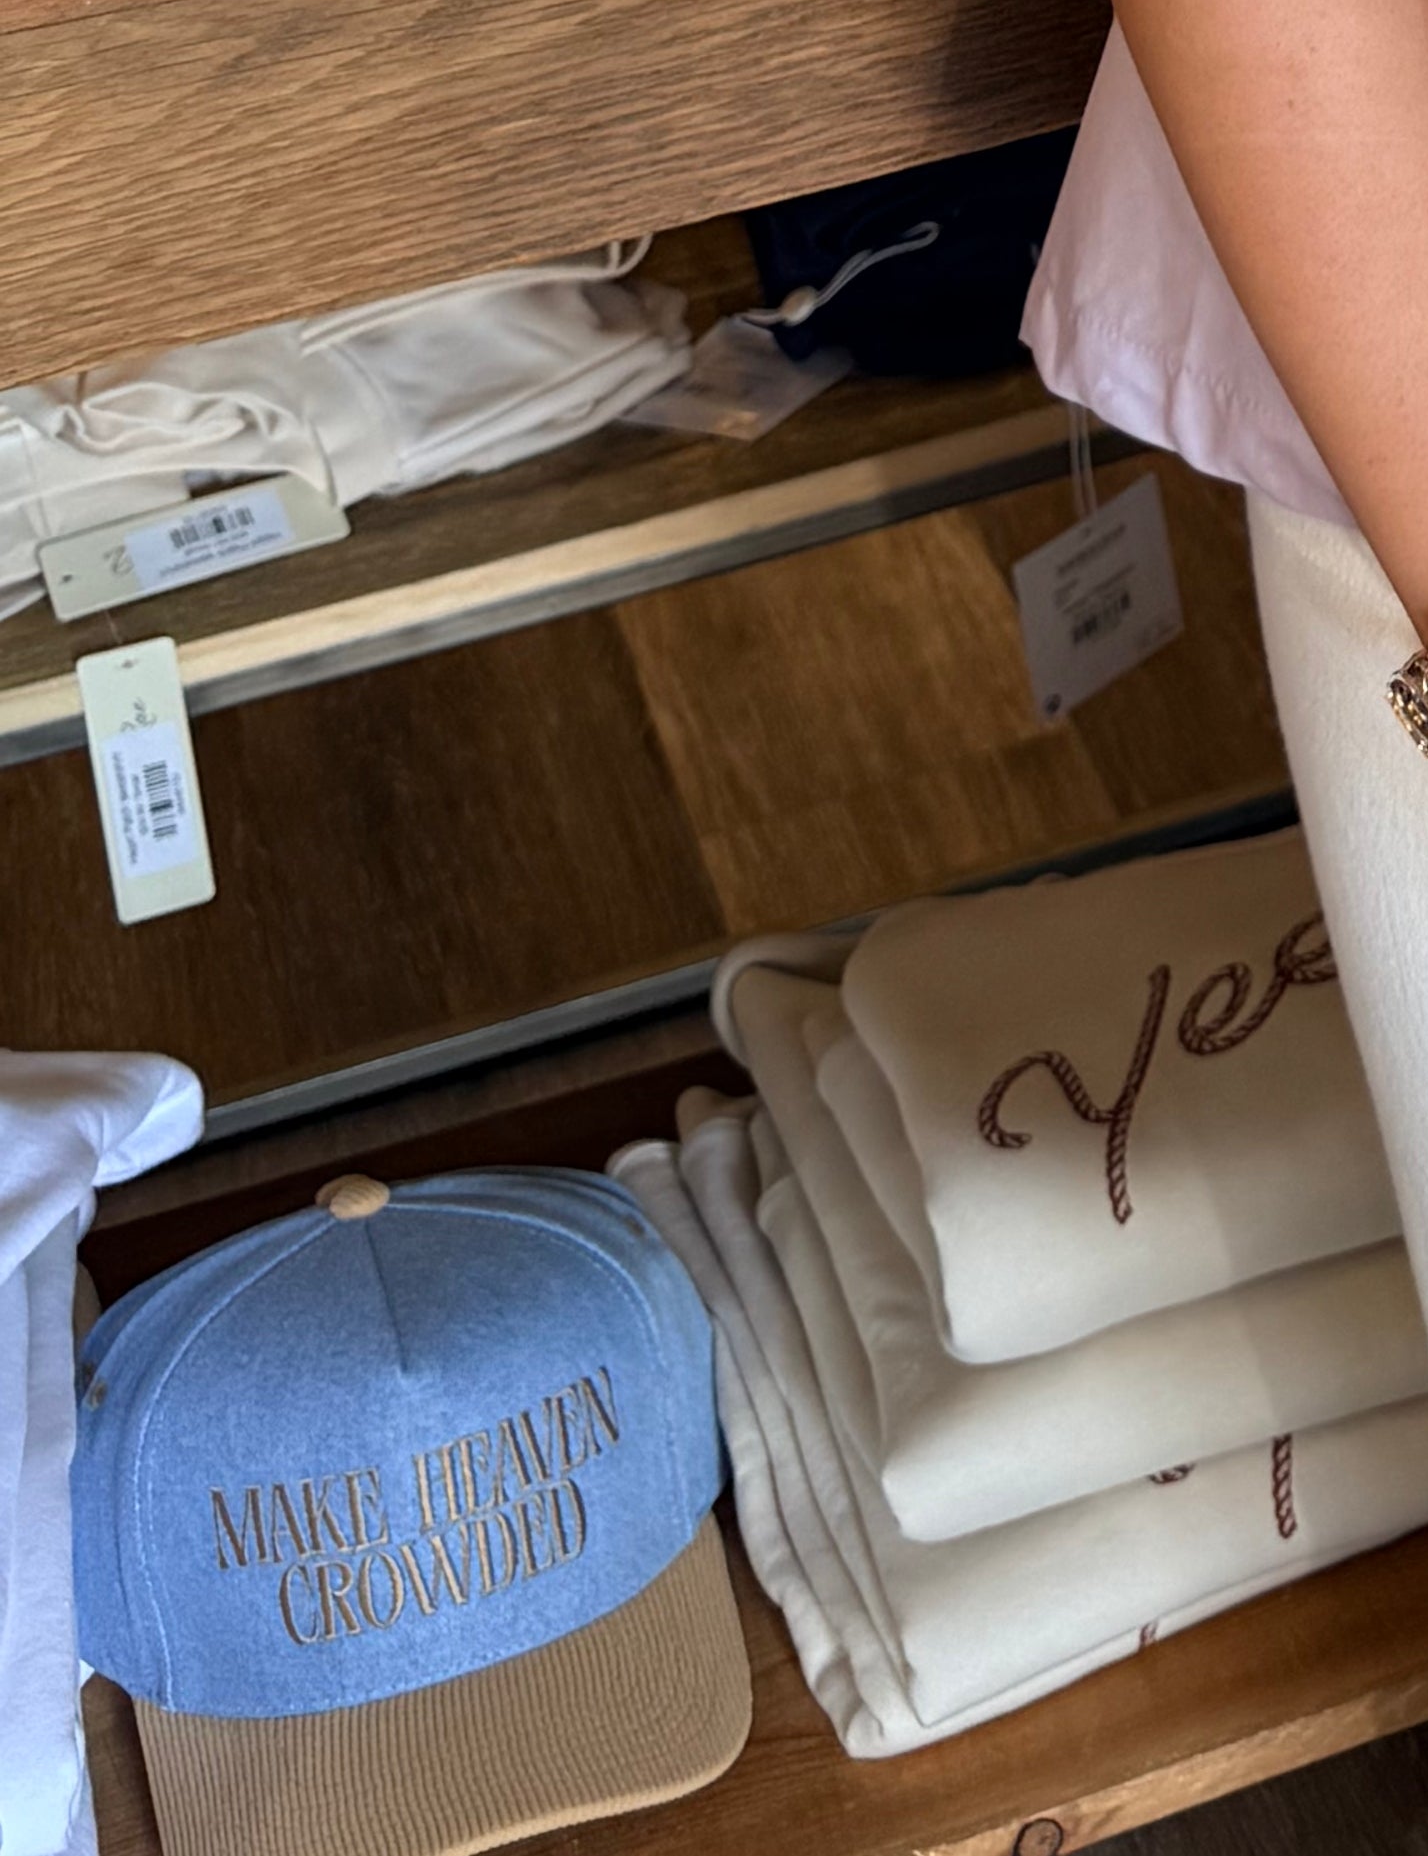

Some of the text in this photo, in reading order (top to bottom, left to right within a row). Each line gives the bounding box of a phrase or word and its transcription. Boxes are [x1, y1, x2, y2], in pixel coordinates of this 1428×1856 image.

[209, 1365, 622, 1571] MAKE HEAVEN
[277, 1477, 588, 1647] CROWDED
